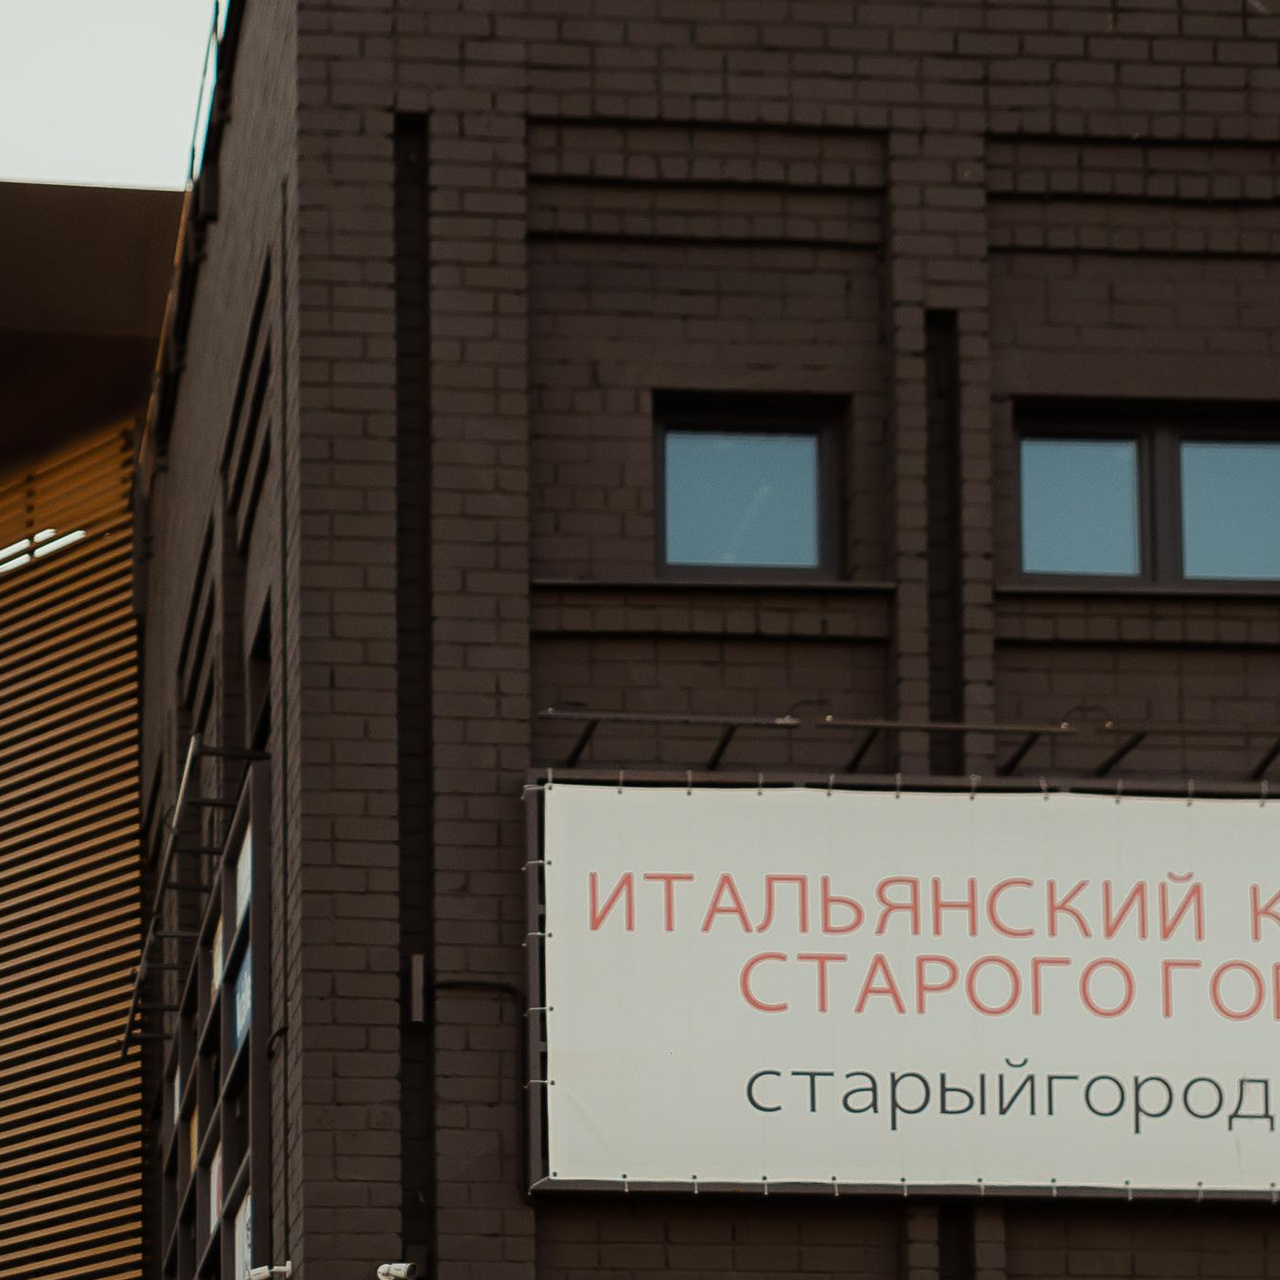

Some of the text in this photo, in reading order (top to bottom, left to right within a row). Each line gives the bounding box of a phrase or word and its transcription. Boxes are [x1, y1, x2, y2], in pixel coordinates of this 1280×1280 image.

[587, 870, 1206, 942] ИТАЛЬЯНСКИЙ
[739, 950, 1280, 1021] СТАРОГО ГО
[745, 1057, 1275, 1134] старыйгород
